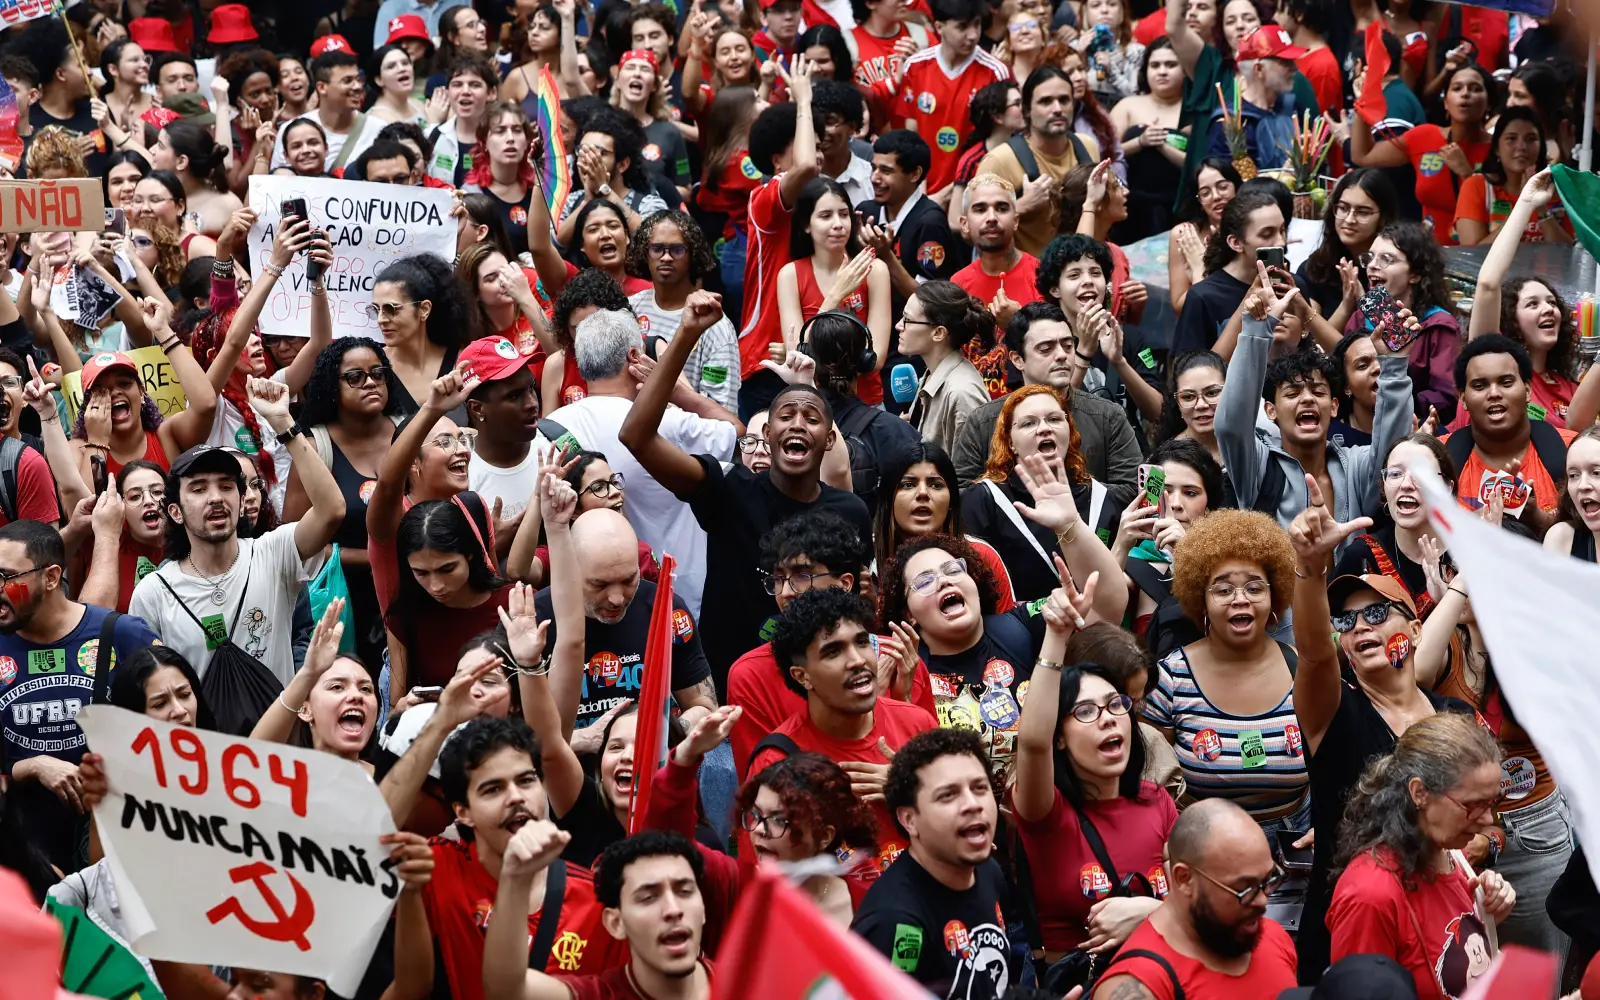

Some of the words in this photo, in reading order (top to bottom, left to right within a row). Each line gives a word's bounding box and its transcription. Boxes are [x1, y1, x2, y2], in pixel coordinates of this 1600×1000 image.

[938, 132, 957, 146] 55
[15, 180, 82, 227] NÃO
[325, 197, 443, 226] CONFUNDA
[261, 223, 275, 243] A
[375, 228, 406, 246] DO
[618, 652, 640, 665] ideais
[70, 676, 94, 690] FED
[4, 728, 30, 749] RURAL
[31, 739, 45, 750] DO
[46, 739, 62, 750] RIO
[63, 737, 77, 749] DE
[62, 724, 77, 732] 1910
[131, 727, 308, 818] 1964
[1500, 772, 1533, 788] ORGULHO
[121, 792, 275, 861] NUNCA
[965, 931, 1005, 970] BOTFOGO
